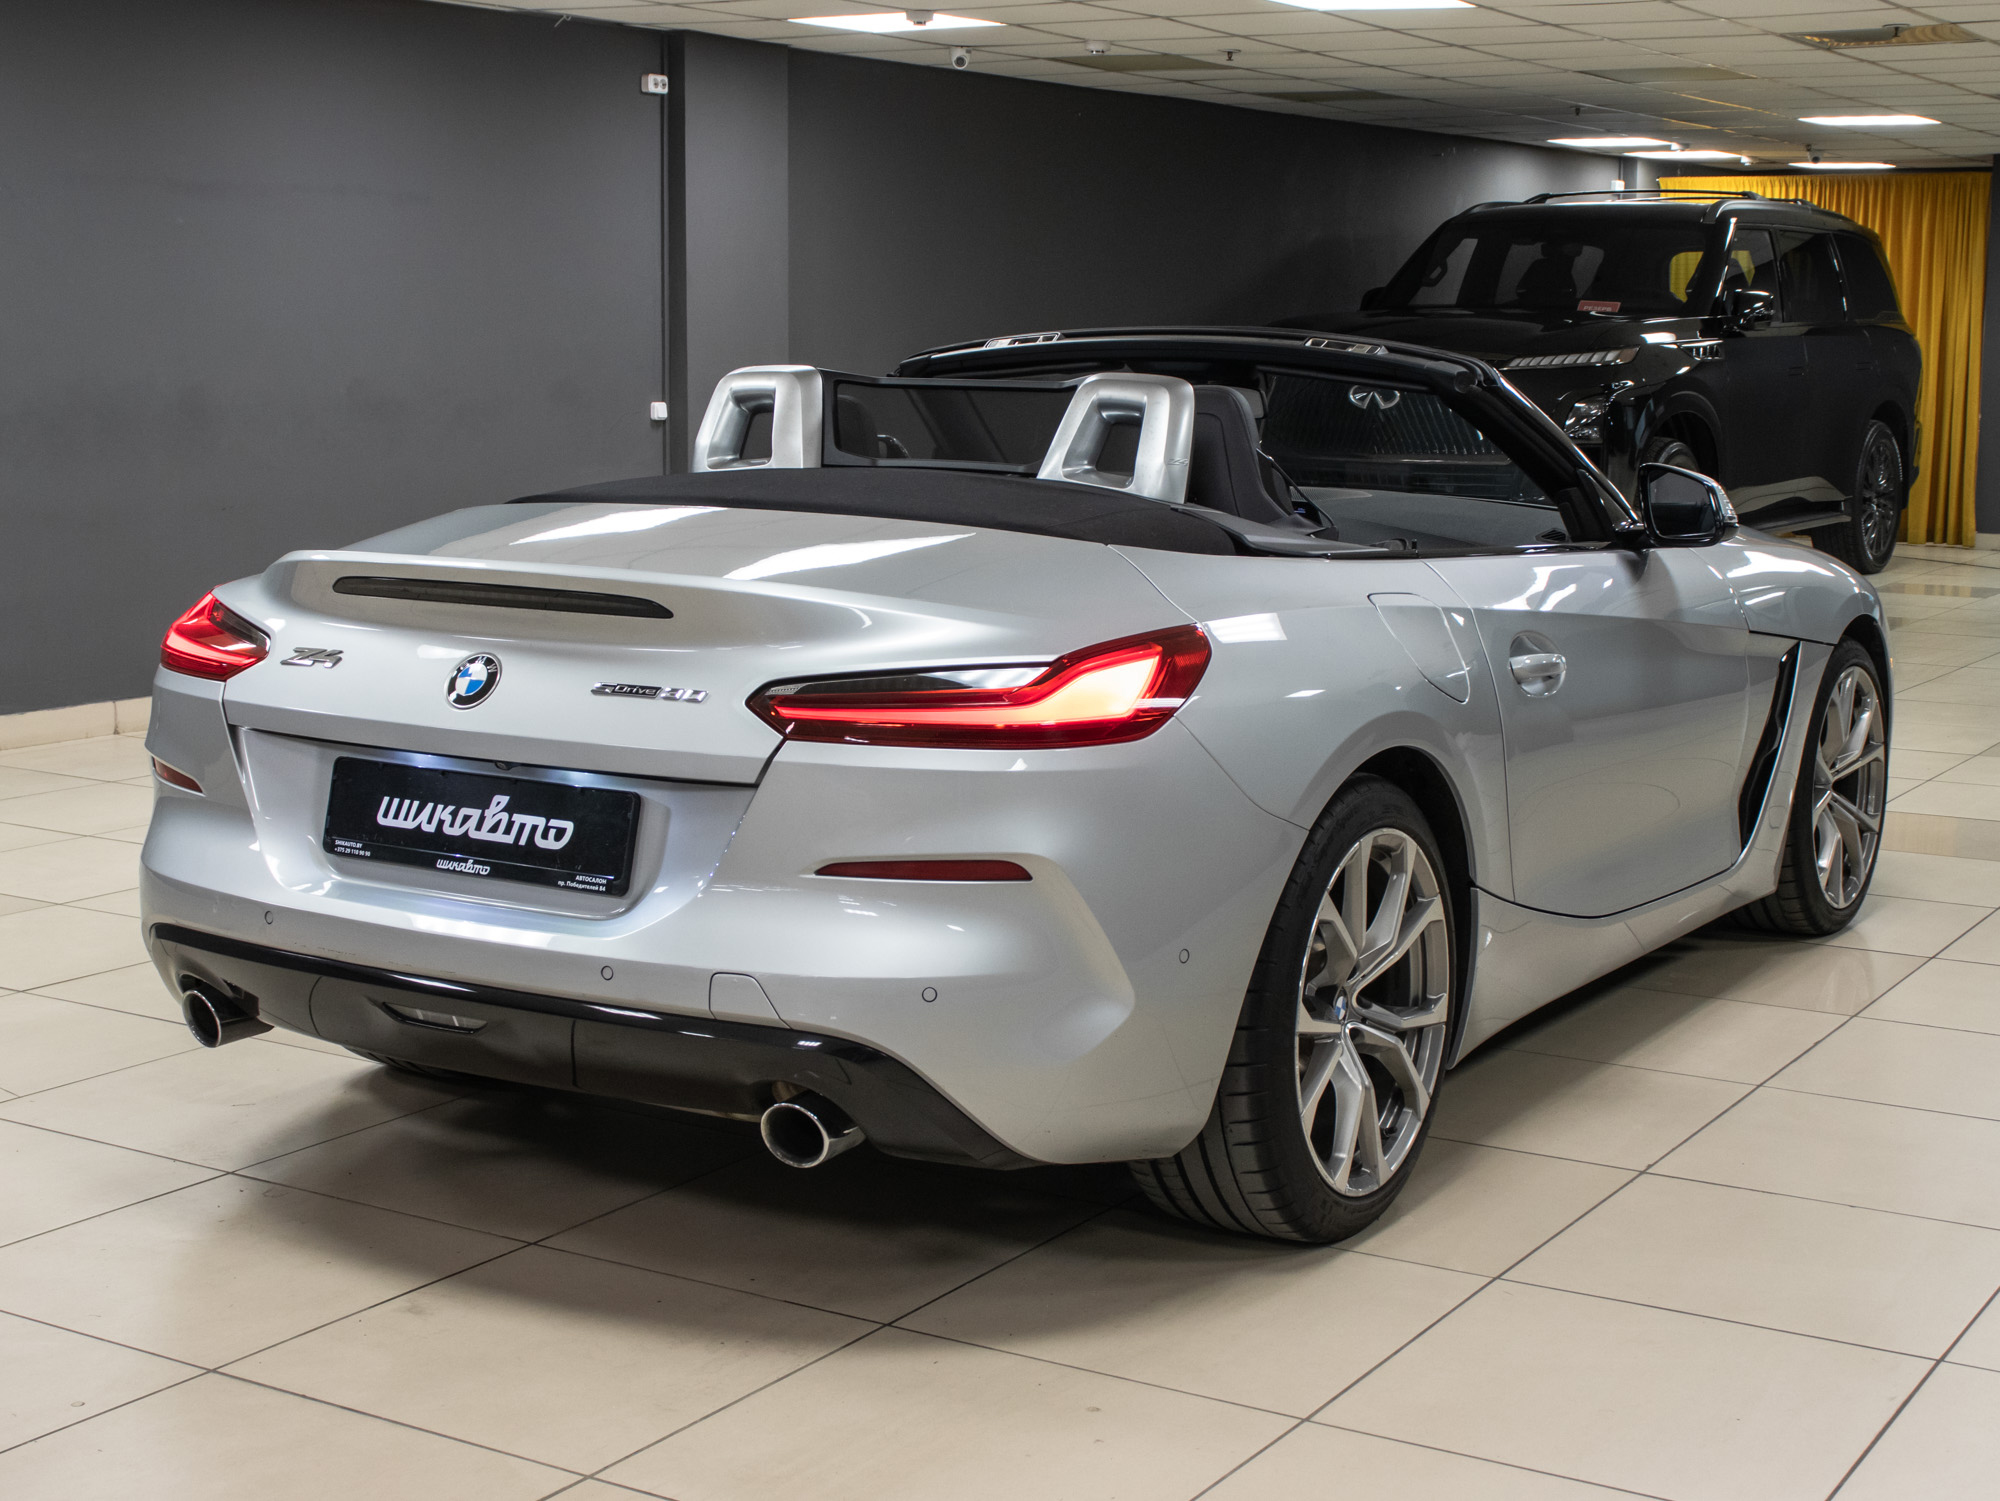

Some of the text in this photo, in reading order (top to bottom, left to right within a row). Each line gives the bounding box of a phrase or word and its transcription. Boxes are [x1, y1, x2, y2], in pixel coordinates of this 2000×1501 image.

[279, 647, 344, 669] Z4
[334, 839, 363, 848] SHIKAUTO.BY
[575, 875, 607, 884] АВТОСАЛОН
[566, 880, 599, 890] Победителей
